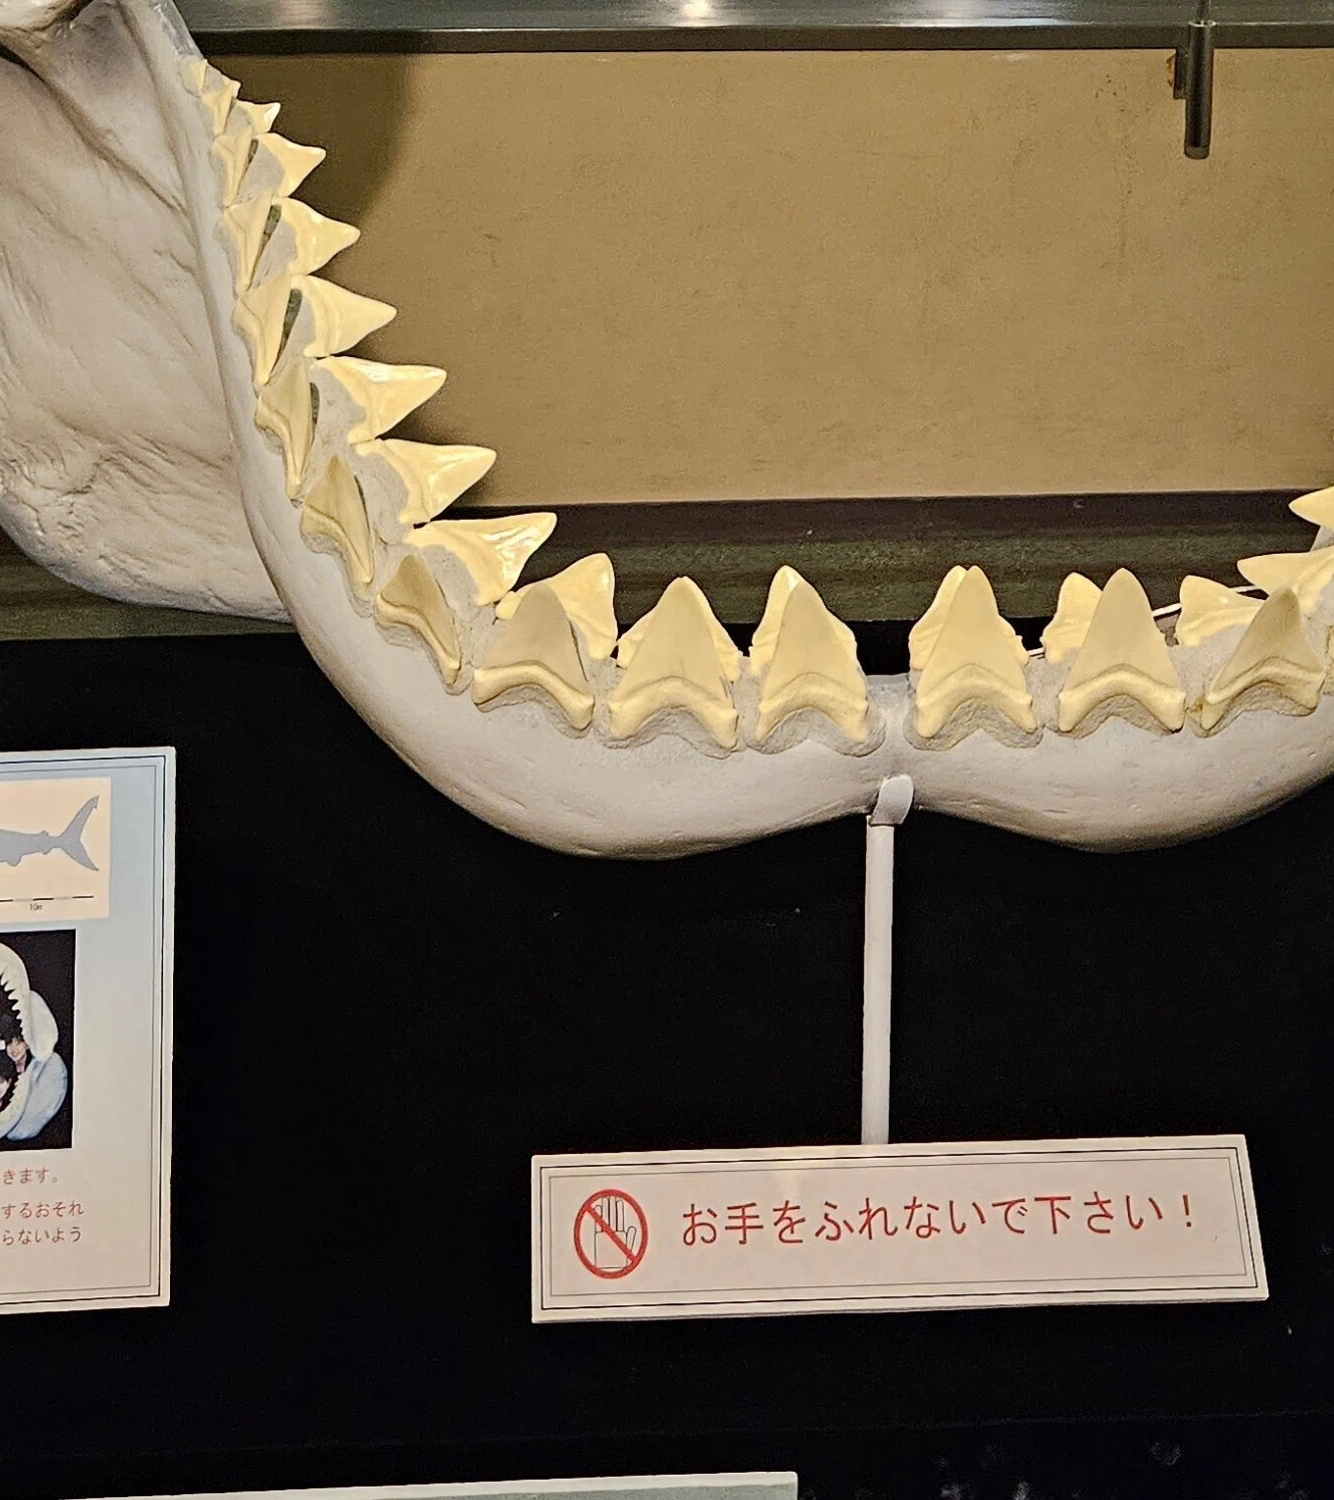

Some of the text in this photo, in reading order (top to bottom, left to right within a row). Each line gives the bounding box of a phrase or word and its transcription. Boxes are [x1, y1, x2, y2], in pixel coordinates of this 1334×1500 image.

[680, 1191, 1196, 1247] お手をふれないで下さい！
